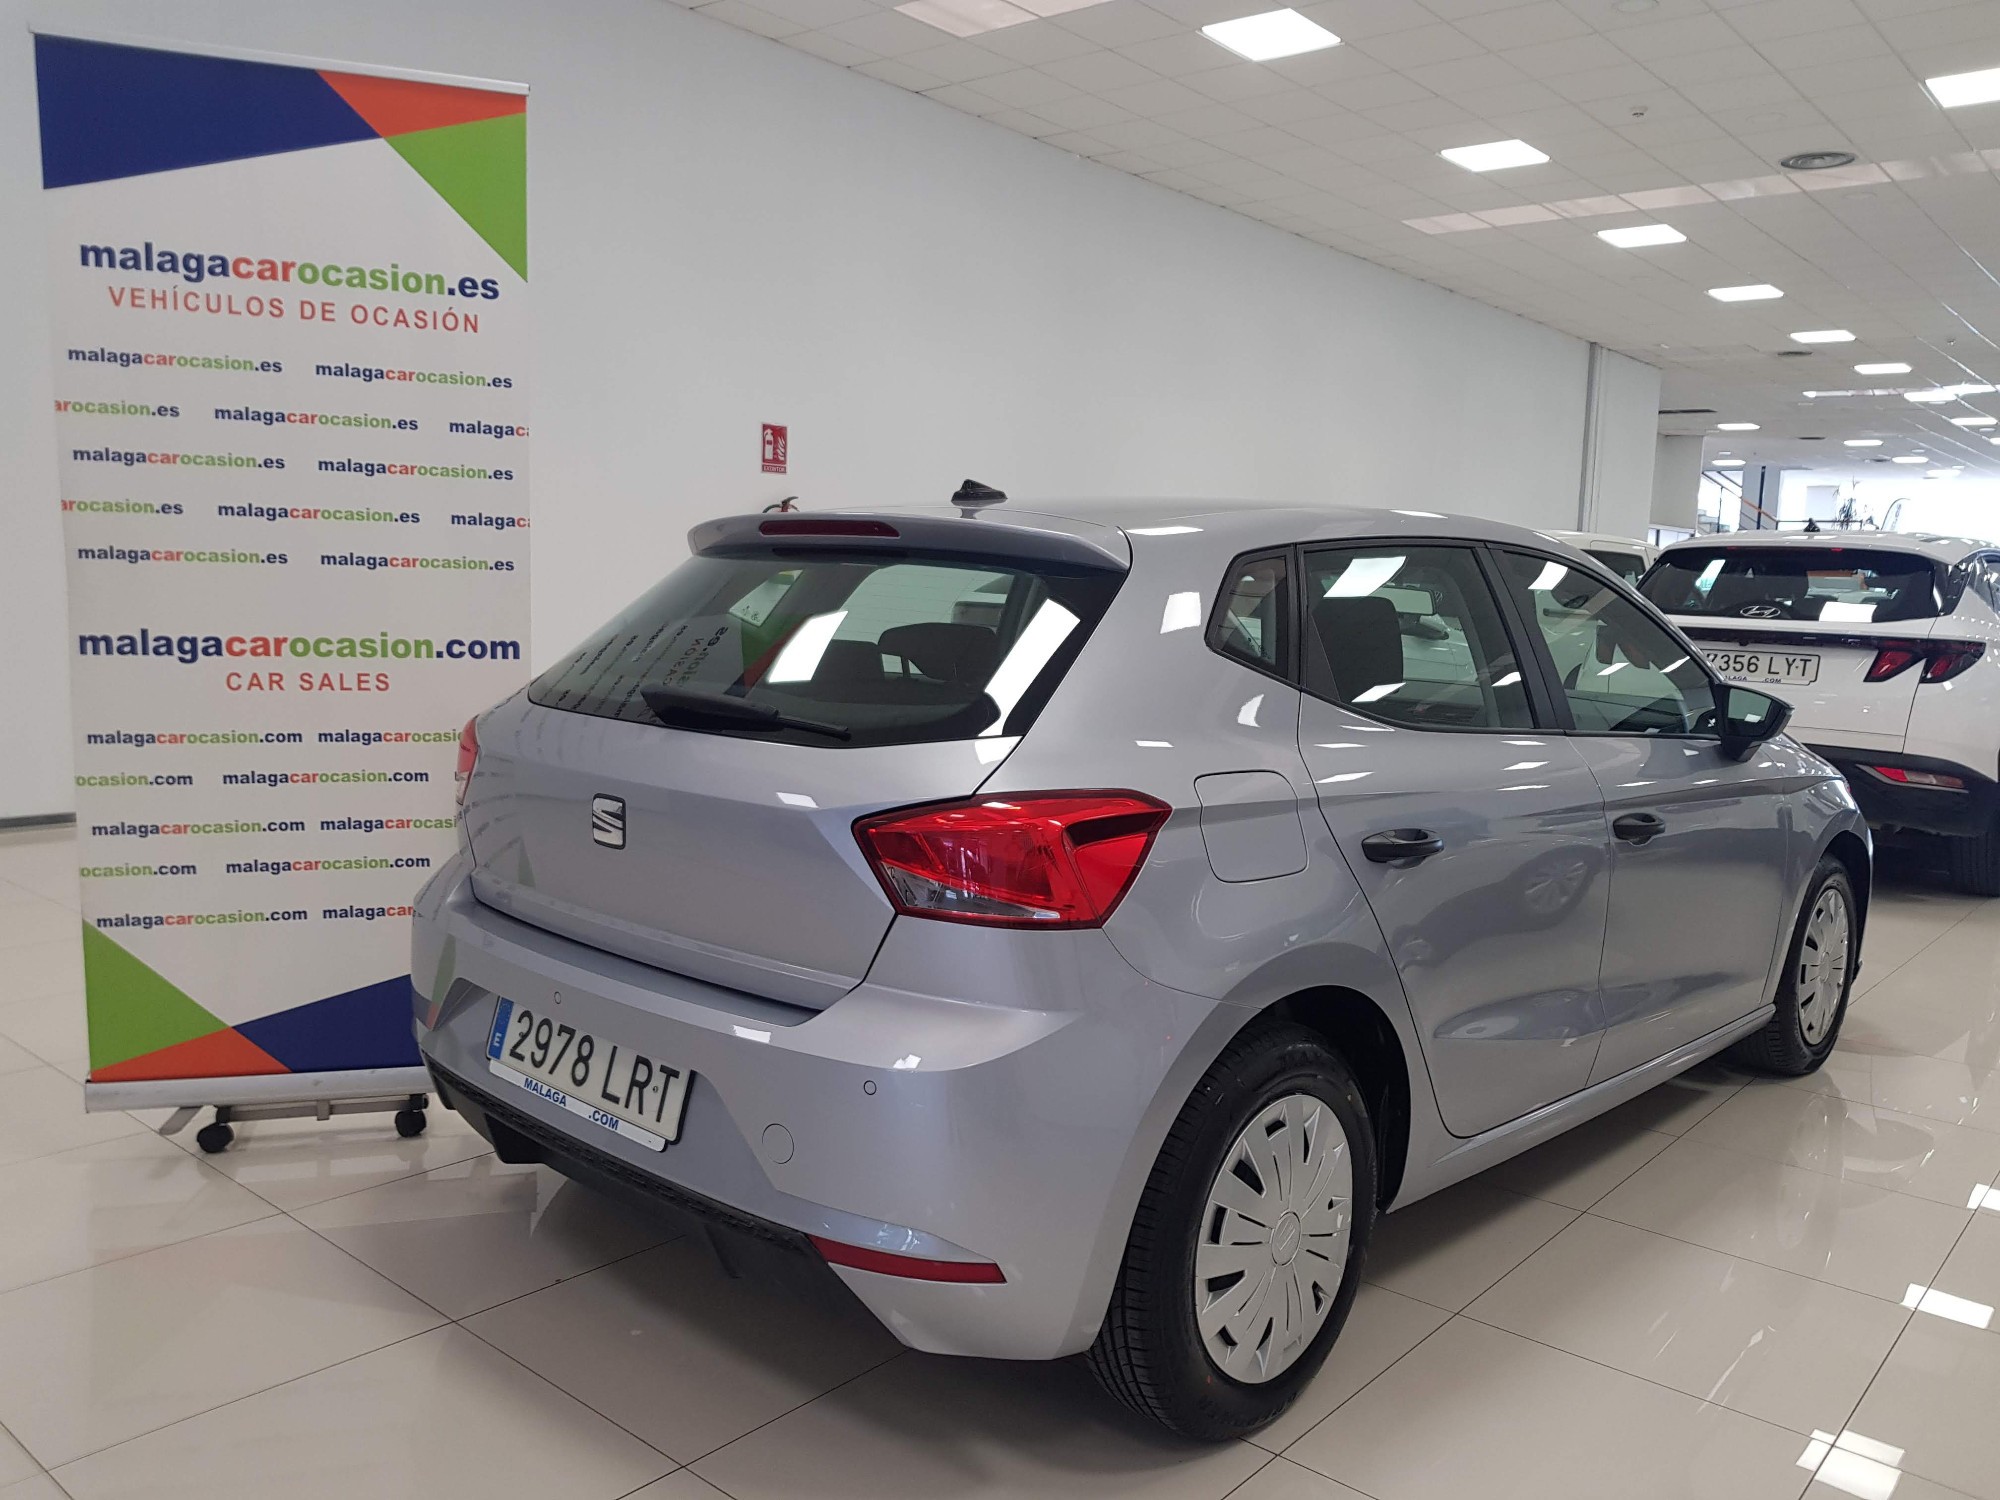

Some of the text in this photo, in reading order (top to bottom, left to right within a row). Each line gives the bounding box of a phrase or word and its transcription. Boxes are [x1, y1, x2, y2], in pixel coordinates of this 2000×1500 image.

[80, 242, 500, 300] malagacarocasion.es
[108, 285, 478, 333] VEHÍCULOS DE OCASIÓN
[68, 348, 282, 372] malagacarocasion.es
[316, 363, 512, 388] malagacarocasion.es
[215, 407, 418, 430] malagacarocasion.es
[449, 420, 529, 439] malagac
[73, 447, 285, 469] malagacarocasion.es
[318, 458, 513, 480] malagacarocasion.es
[218, 503, 420, 523] malagacarocasion.es
[451, 512, 530, 530] malagac
[78, 545, 288, 564] malagacarocasion.es
[321, 552, 514, 571] malagacarocasion.es
[79, 628, 520, 664] malagacarocasion.com
[226, 672, 389, 691] CAR SALES
[87, 730, 302, 747] malagacarocasion.com
[318, 729, 461, 746] malagacarocasi
[223, 771, 429, 787] malagacarocasion.com
[92, 820, 305, 838] malagacarocasion.com
[226, 856, 430, 875] malagacarocasion.com
[96, 909, 308, 930] malagacarocasion.com
[509, 1010, 680, 1123] 2978 LRT
[524, 1077, 620, 1131] MALAGA .COM
